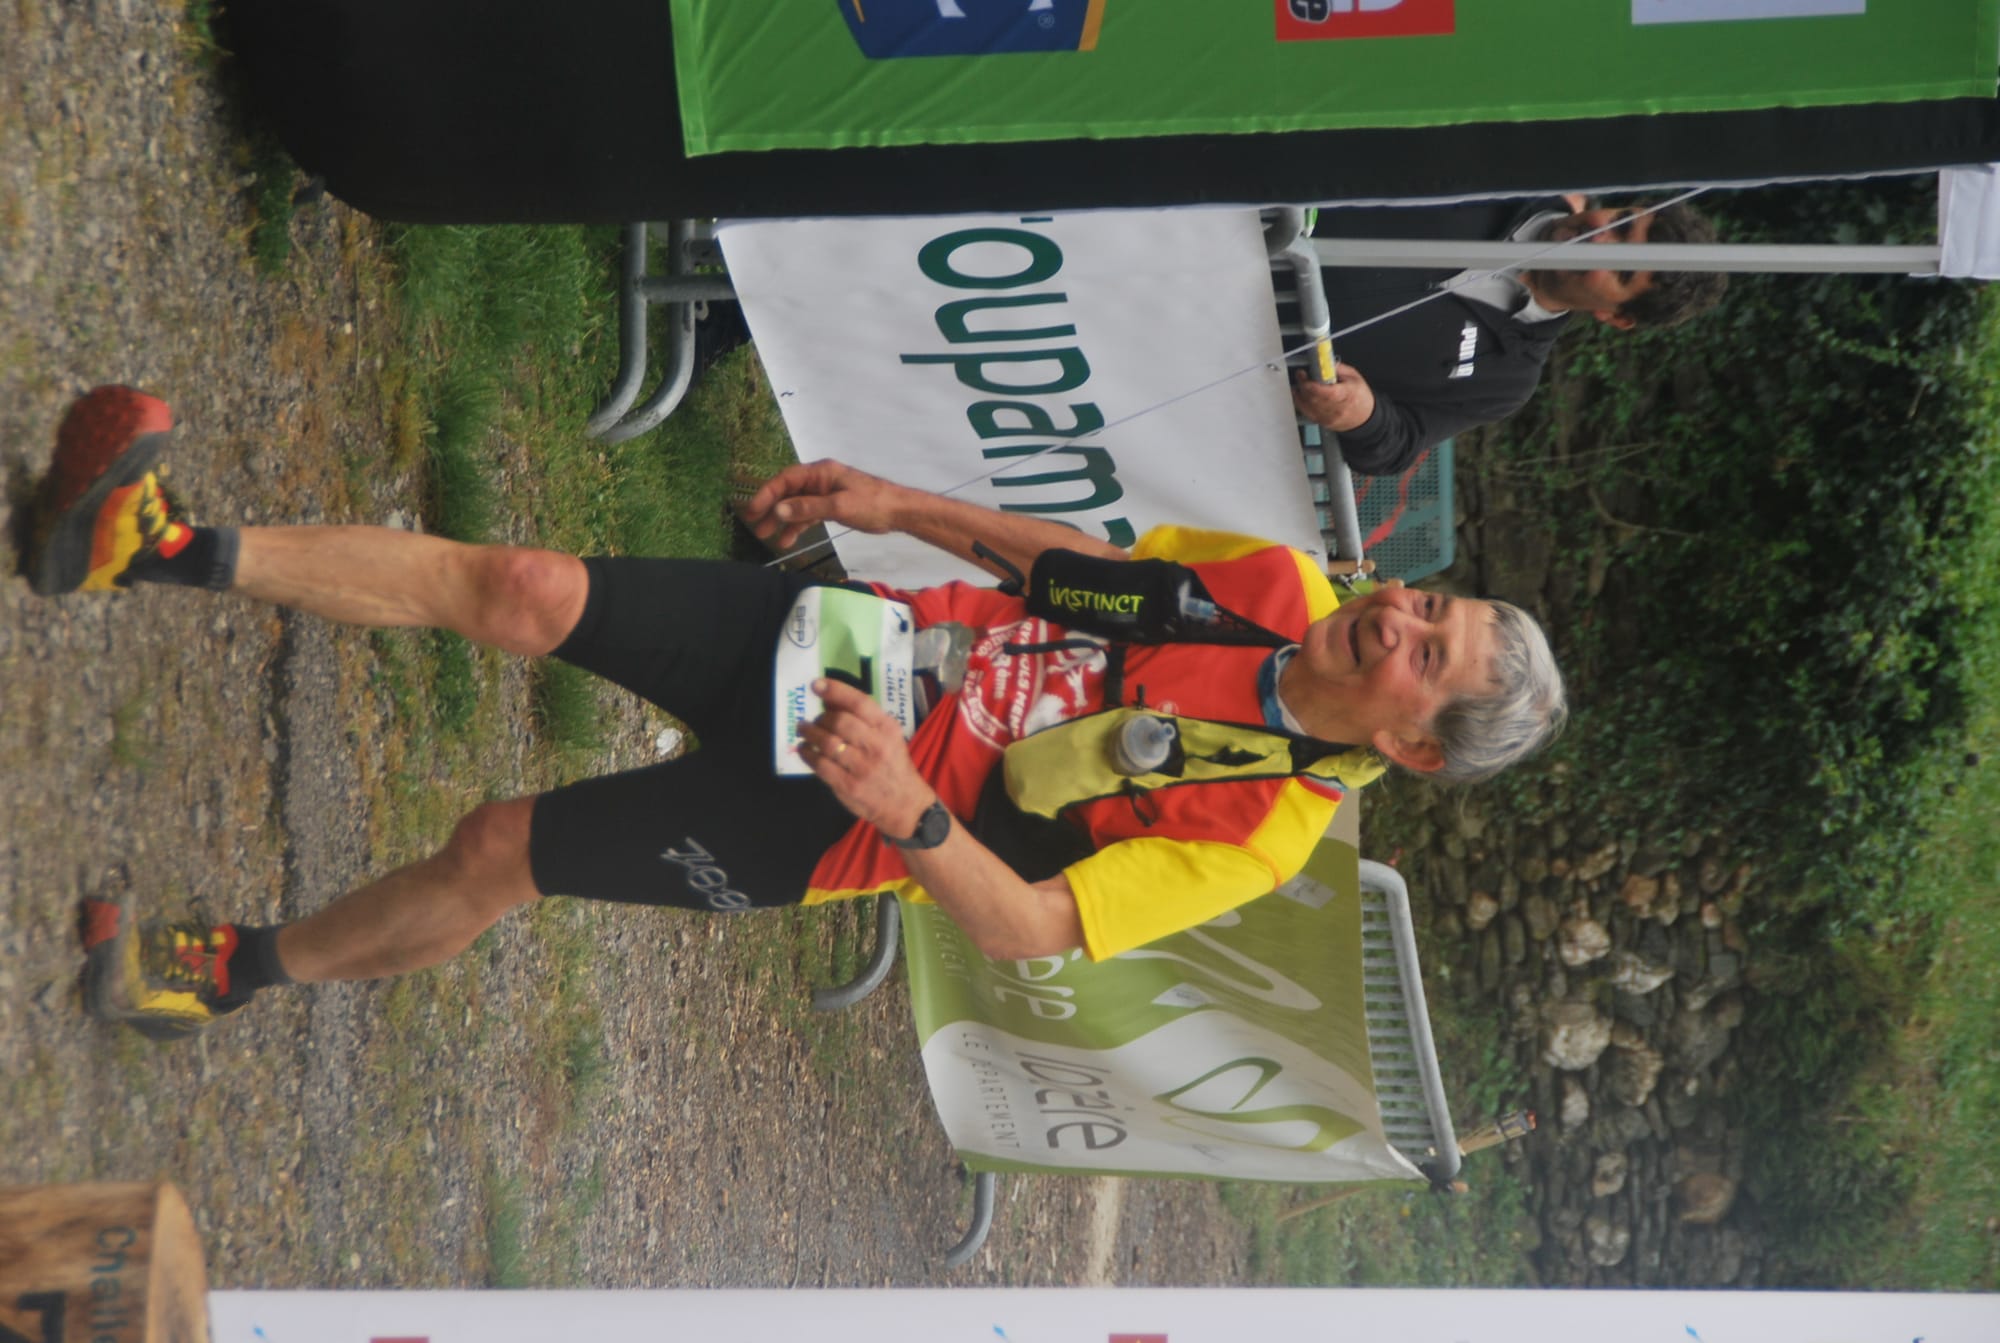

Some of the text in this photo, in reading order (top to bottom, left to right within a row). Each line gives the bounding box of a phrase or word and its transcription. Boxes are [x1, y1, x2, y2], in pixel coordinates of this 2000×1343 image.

[899, 217, 1137, 549] oupam
[1009, 690, 1028, 739] MEN
[984, 947, 1083, 1020] ère
[969, 1058, 1020, 1149] PARTEMENT
